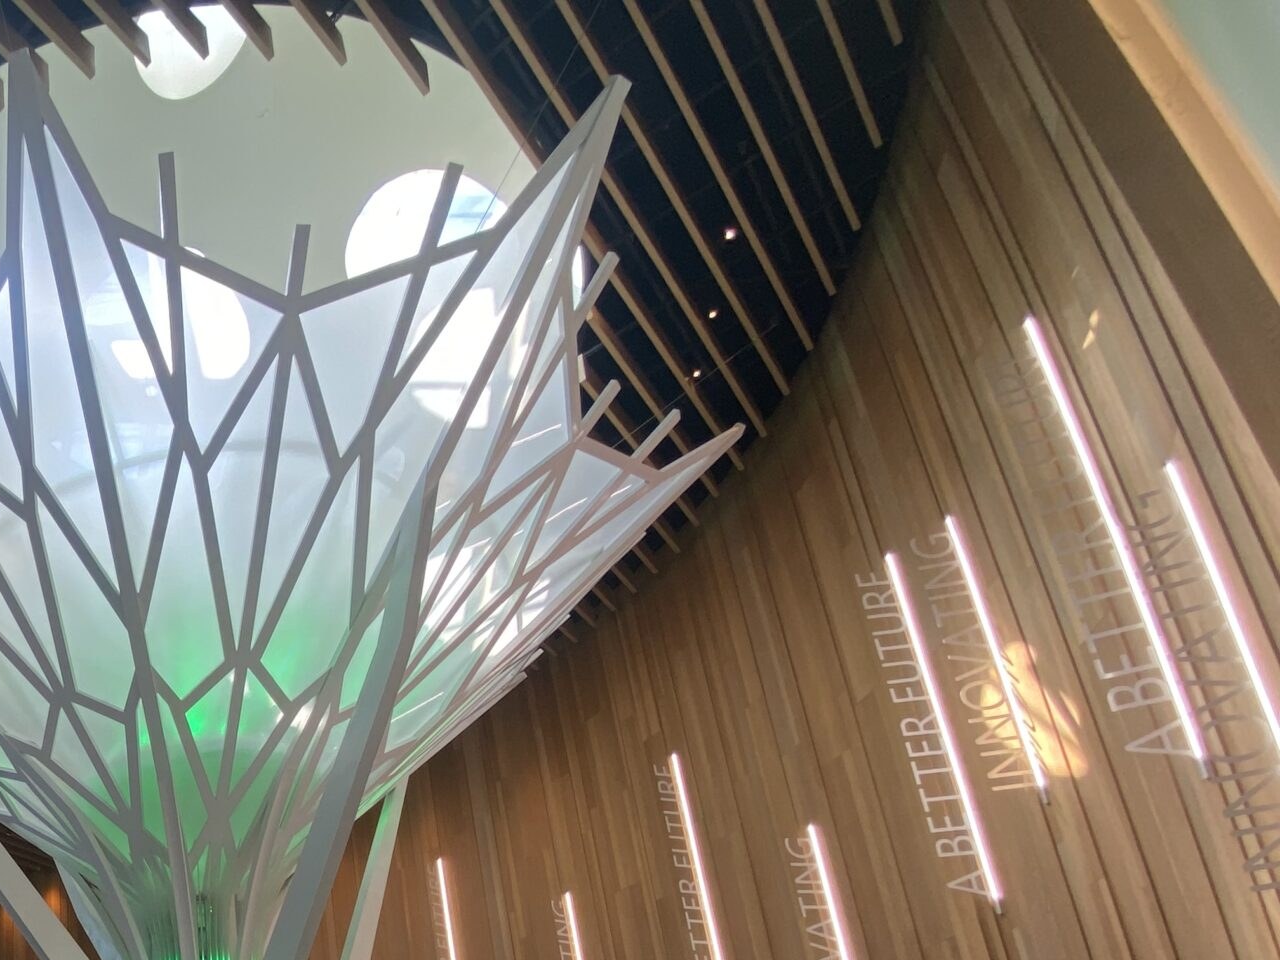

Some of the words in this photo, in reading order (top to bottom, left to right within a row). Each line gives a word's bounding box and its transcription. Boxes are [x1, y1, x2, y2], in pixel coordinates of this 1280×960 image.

[855, 571, 931, 704] FUTURE
[910, 531, 1035, 792] INNOVATING
[653, 763, 693, 869] FUTURE
[900, 711, 976, 859] BETTER
[946, 868, 992, 898] A
